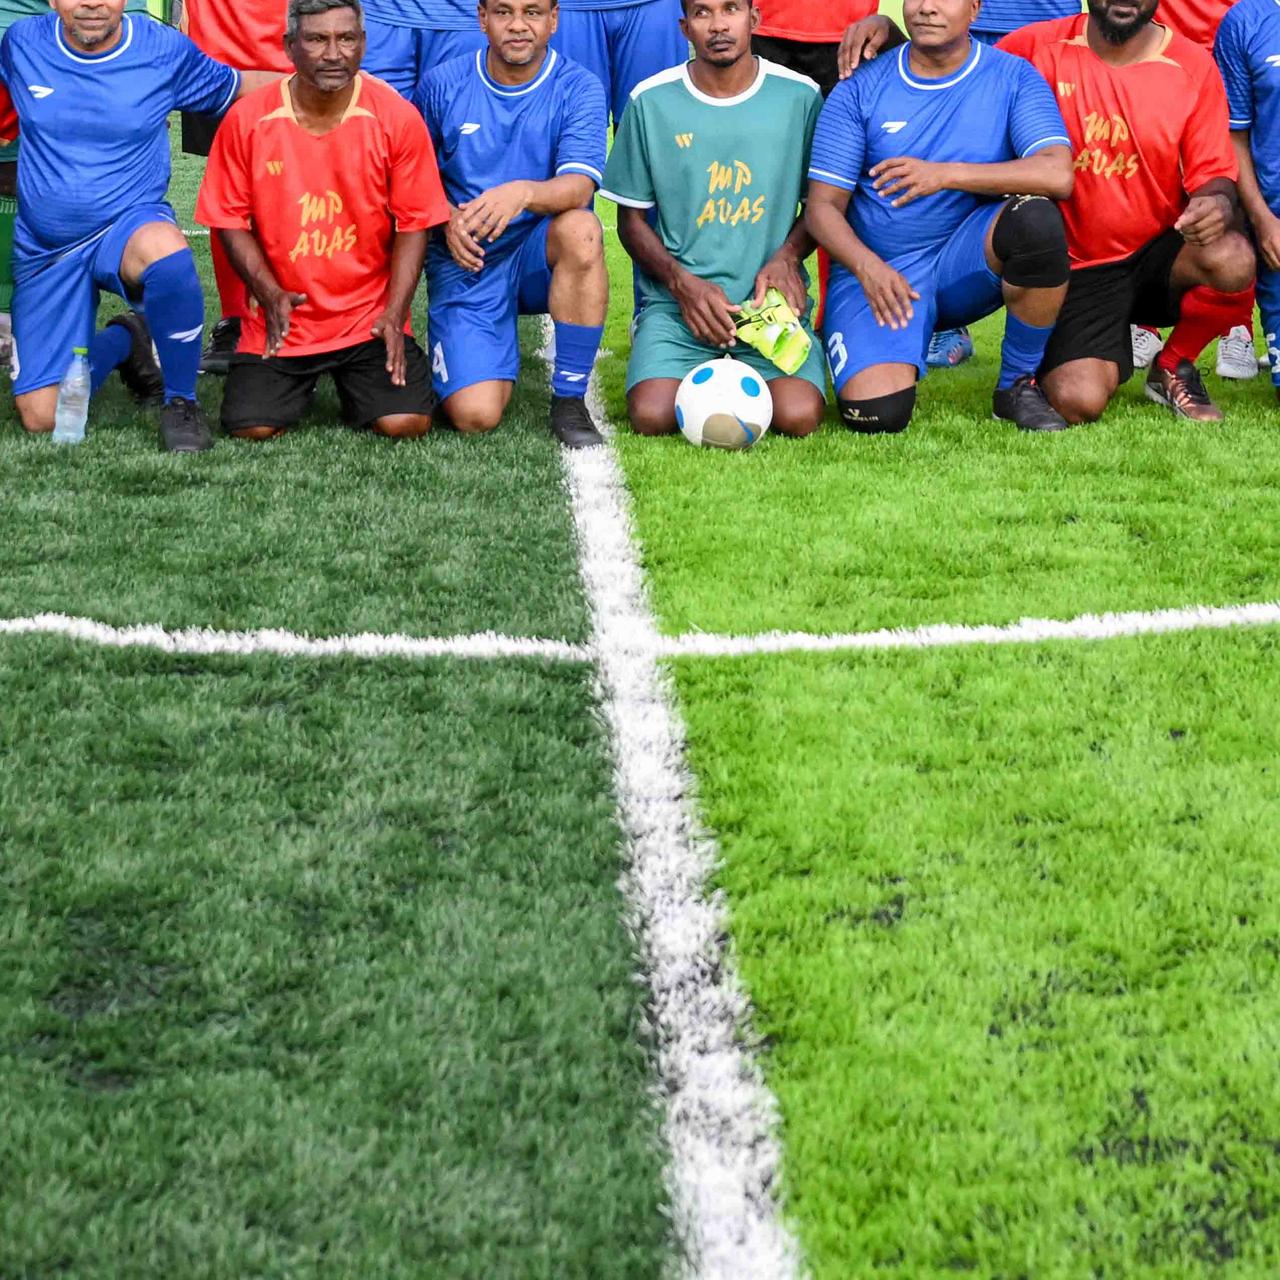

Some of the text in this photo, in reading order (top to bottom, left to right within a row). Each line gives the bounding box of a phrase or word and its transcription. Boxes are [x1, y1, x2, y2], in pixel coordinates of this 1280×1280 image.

[1083, 110, 1130, 148] MP
[706, 159, 752, 195] MP
[298, 189, 343, 227] MP
